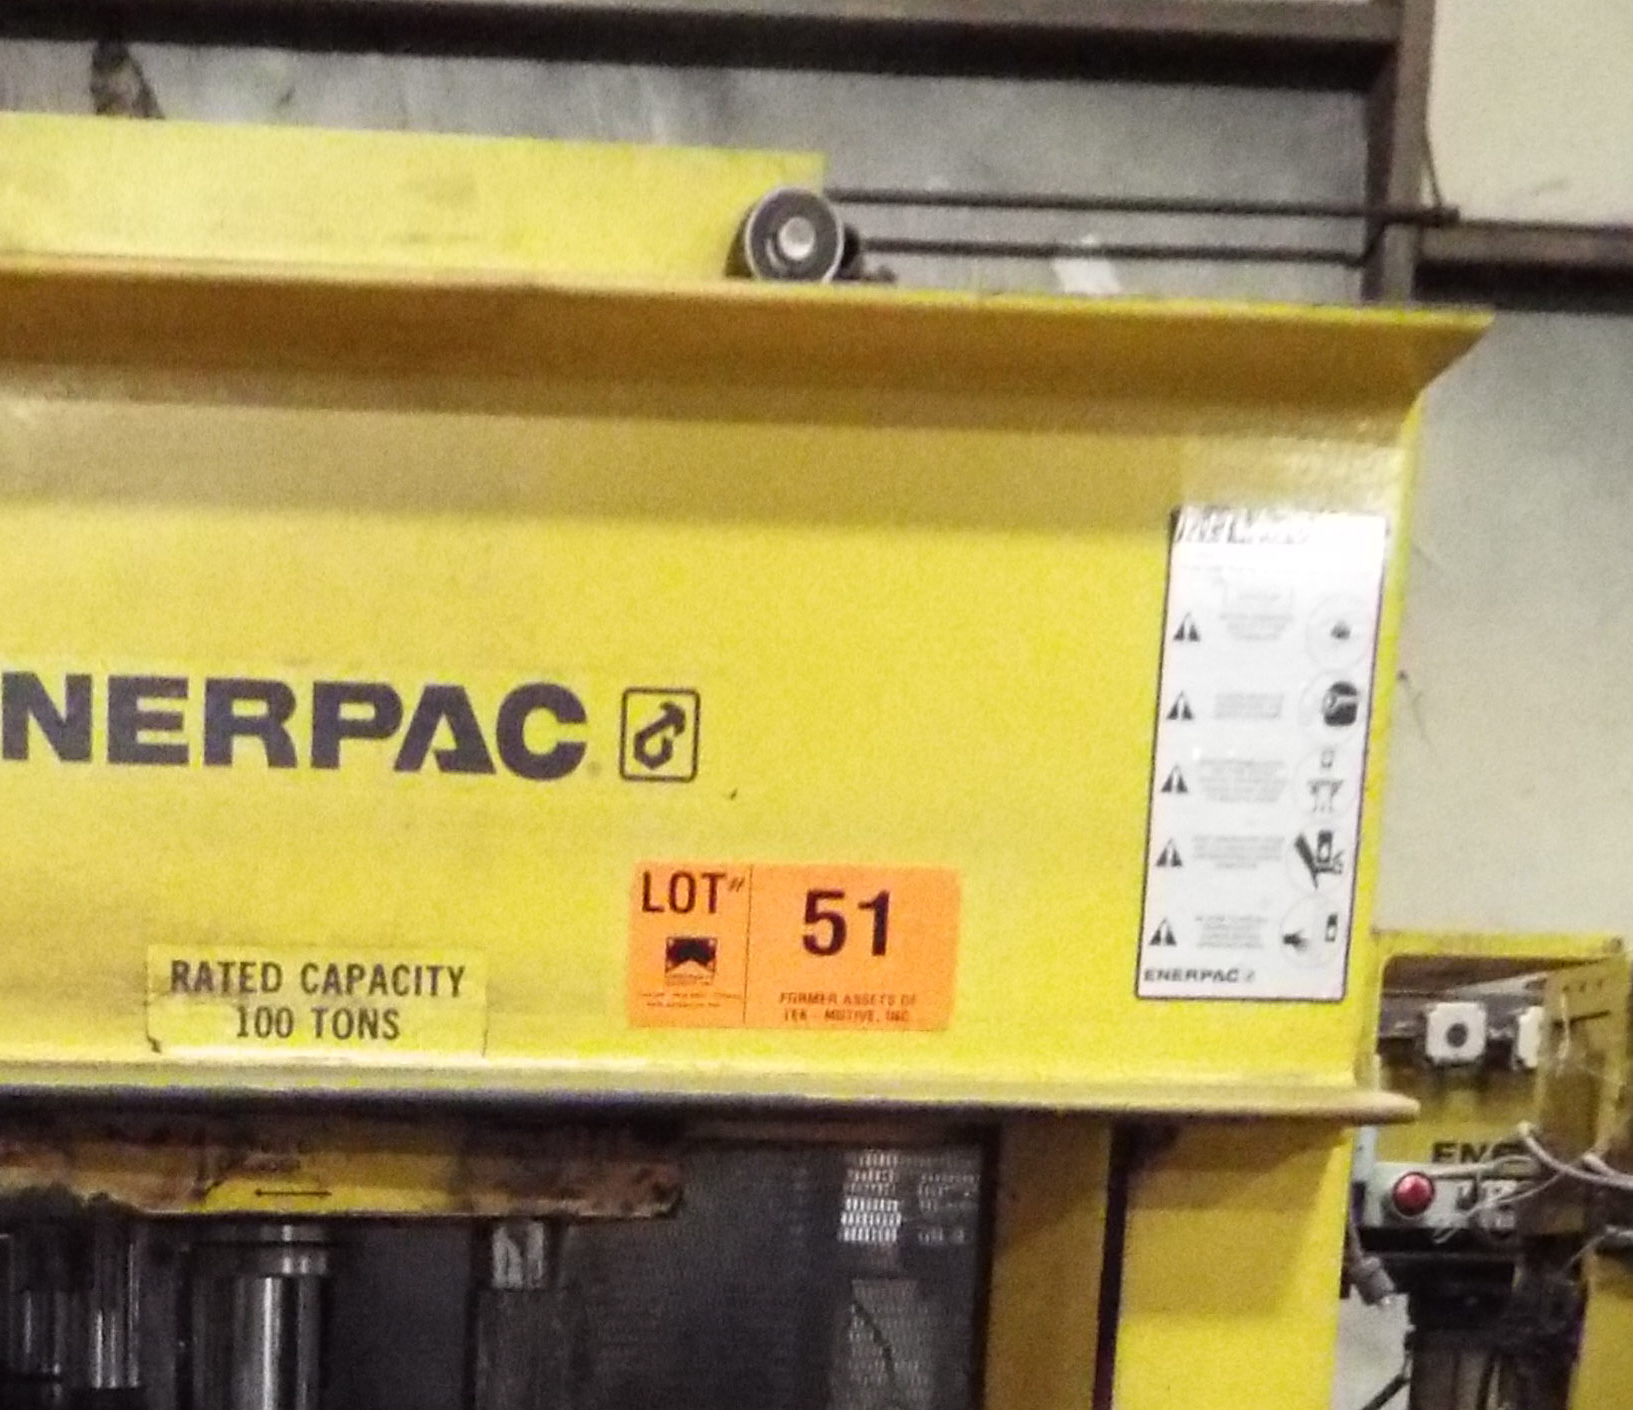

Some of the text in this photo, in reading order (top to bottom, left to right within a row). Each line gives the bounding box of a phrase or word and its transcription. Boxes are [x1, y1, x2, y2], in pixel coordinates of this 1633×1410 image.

[801, 888, 891, 957] 51
[170, 959, 466, 998] RATED CAPACITY
[1143, 967, 1240, 983] ENERPAC
[236, 1005, 401, 1041] 100 TONS
